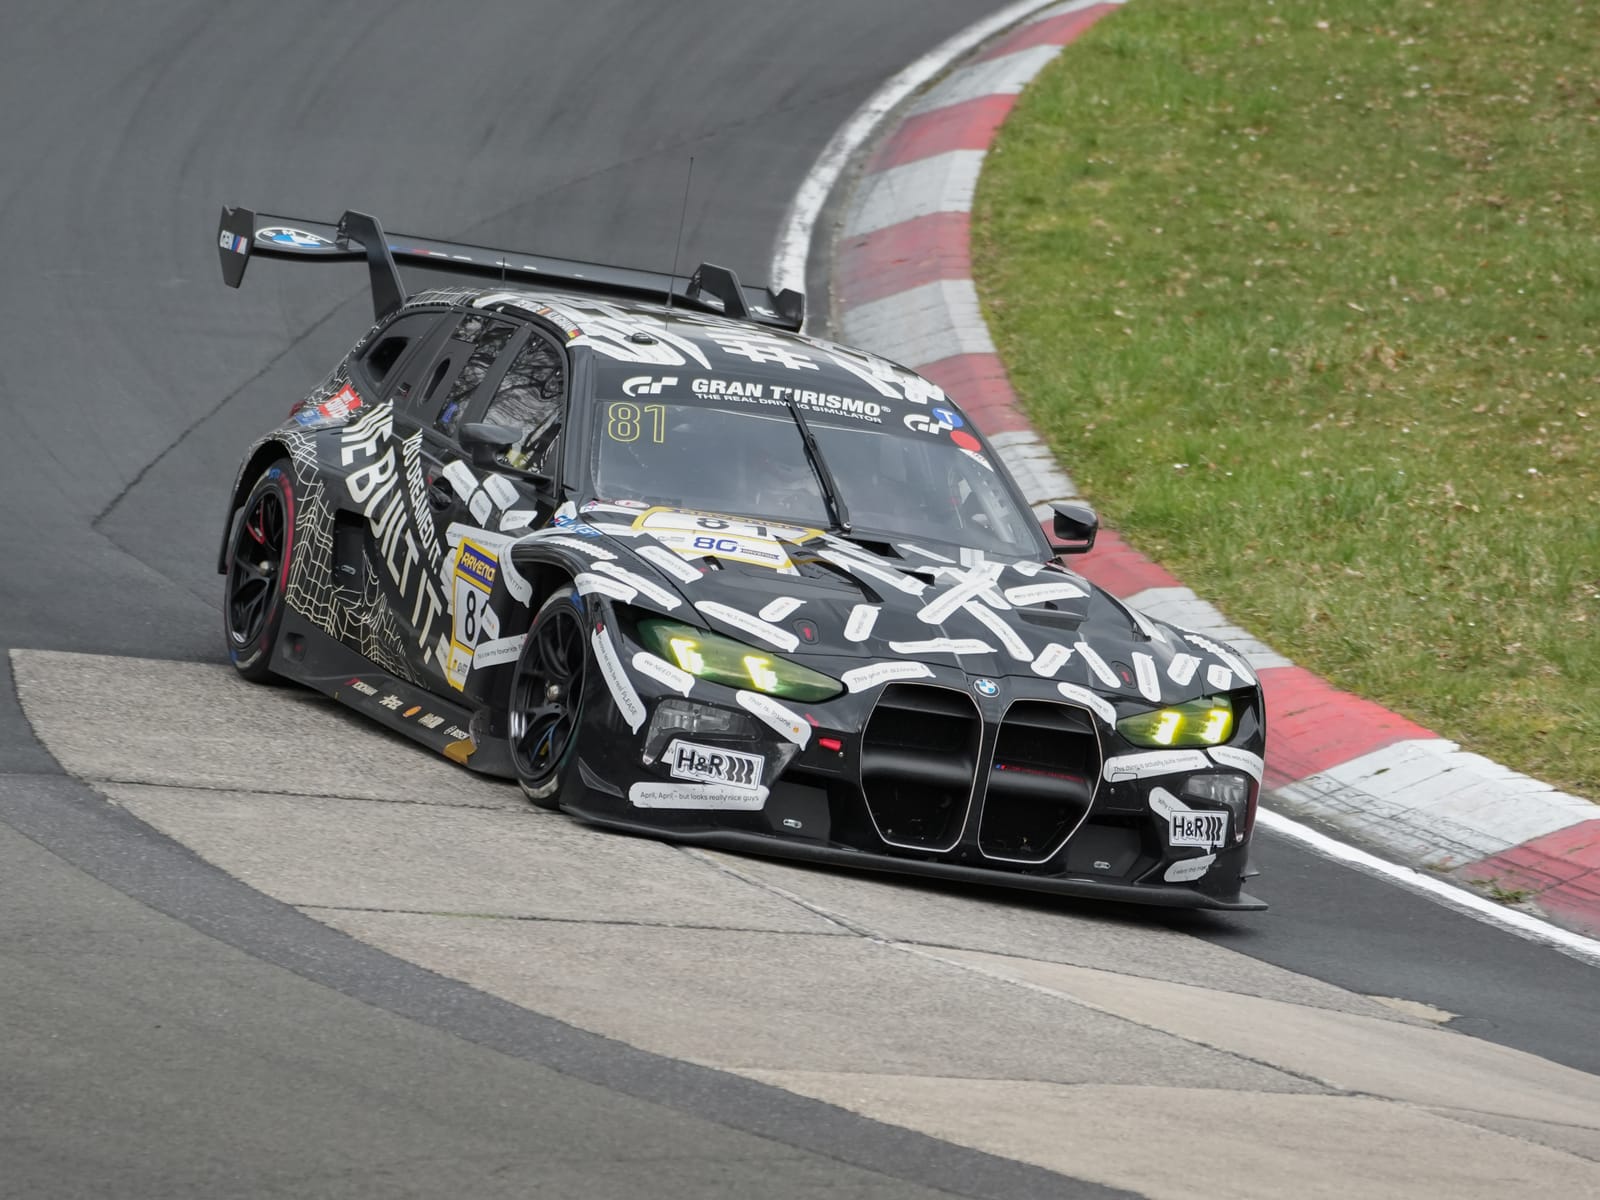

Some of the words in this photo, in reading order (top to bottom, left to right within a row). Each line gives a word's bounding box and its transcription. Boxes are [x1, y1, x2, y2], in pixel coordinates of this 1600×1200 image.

[691, 378, 762, 397] GRAN
[607, 402, 666, 444] 81
[695, 393, 717, 401] THE
[724, 395, 757, 404] REAL
[811, 405, 882, 424] SIMULATOR
[341, 398, 393, 466] WE
[402, 428, 423, 467] YOU
[406, 456, 435, 549] DREAMED
[345, 445, 418, 599] BUILT
[619, 689, 638, 716] PLEASE
[677, 748, 724, 776] H&R
[679, 792, 690, 800] but
[690, 792, 708, 801] looks
[709, 792, 727, 803] really
[728, 793, 742, 801] nice
[1173, 816, 1204, 837] H&R
